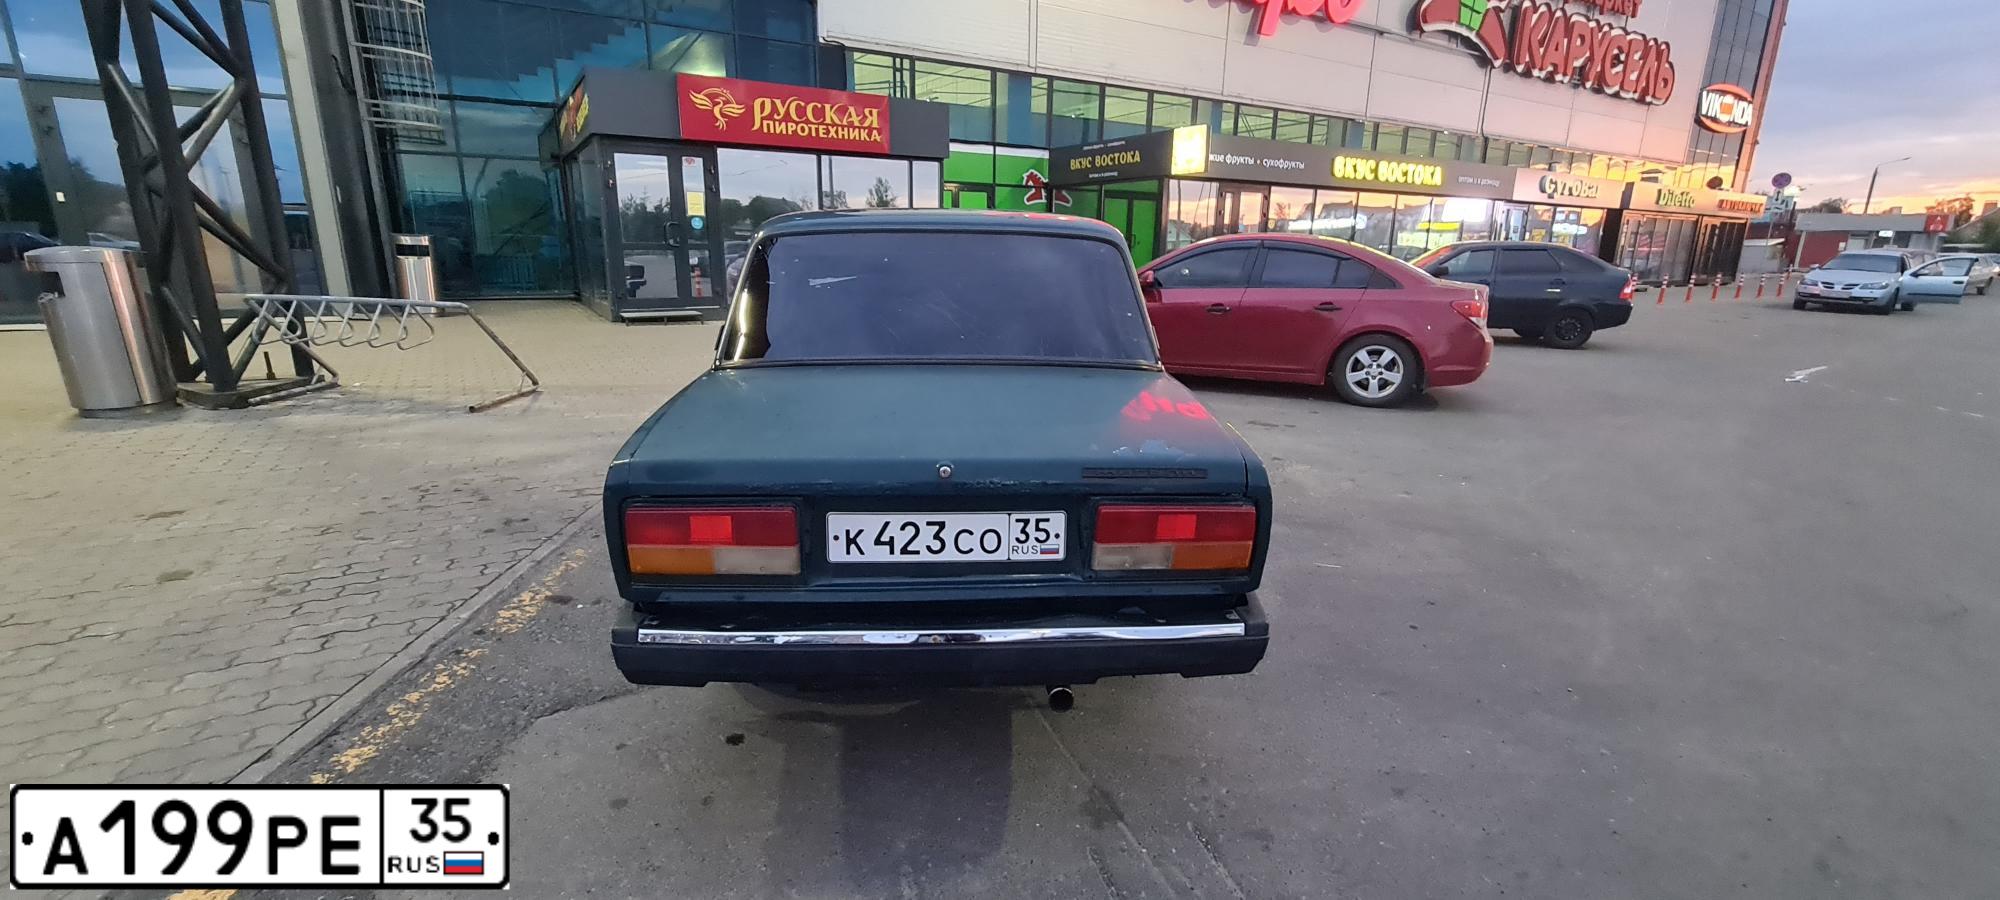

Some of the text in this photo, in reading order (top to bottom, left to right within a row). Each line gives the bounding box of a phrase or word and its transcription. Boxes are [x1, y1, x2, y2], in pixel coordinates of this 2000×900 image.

[1515, 1, 1674, 105] КАРУСЕЛЬ
[752, 97, 881, 130] РУССКАЯ
[763, 120, 881, 142] ПИРОТЕХНИКА
[1070, 150, 1140, 170] ВКУС ВОСТОКА
[1225, 153, 1255, 165] фрукты
[1262, 158, 1305, 169] сухофрукты
[1333, 155, 1442, 186] ВКУС ВОСТОКА
[1014, 518, 1051, 544] 35
[1011, 544, 1039, 555] RUS
